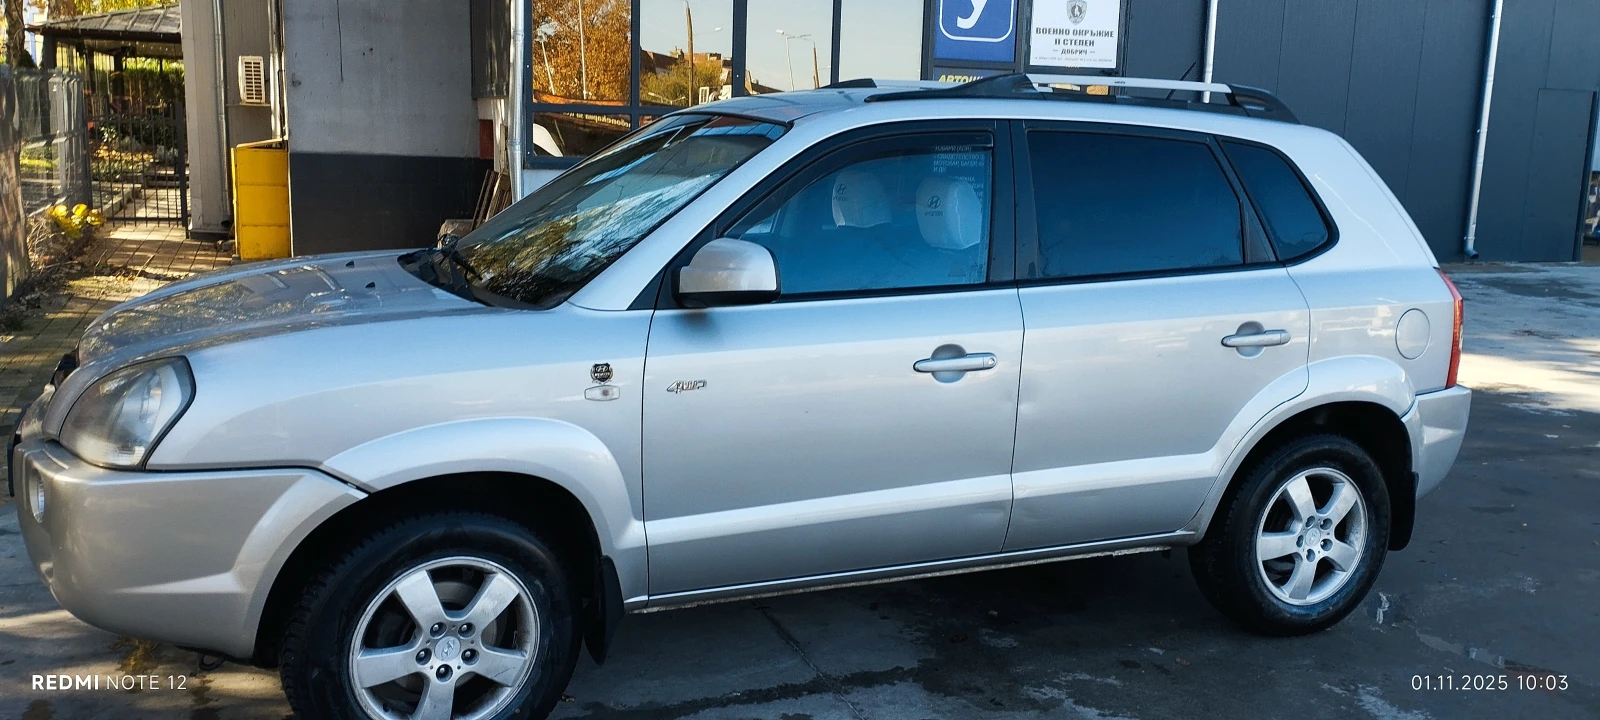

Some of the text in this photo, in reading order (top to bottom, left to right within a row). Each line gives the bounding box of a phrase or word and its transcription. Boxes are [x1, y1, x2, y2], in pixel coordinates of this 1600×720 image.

[1035, 27, 1115, 38] ВОЕННО ОКРЪЖИЕ
[1062, 39, 1095, 47] СТЕПЕН
[938, 74, 984, 84] АВТОШ
